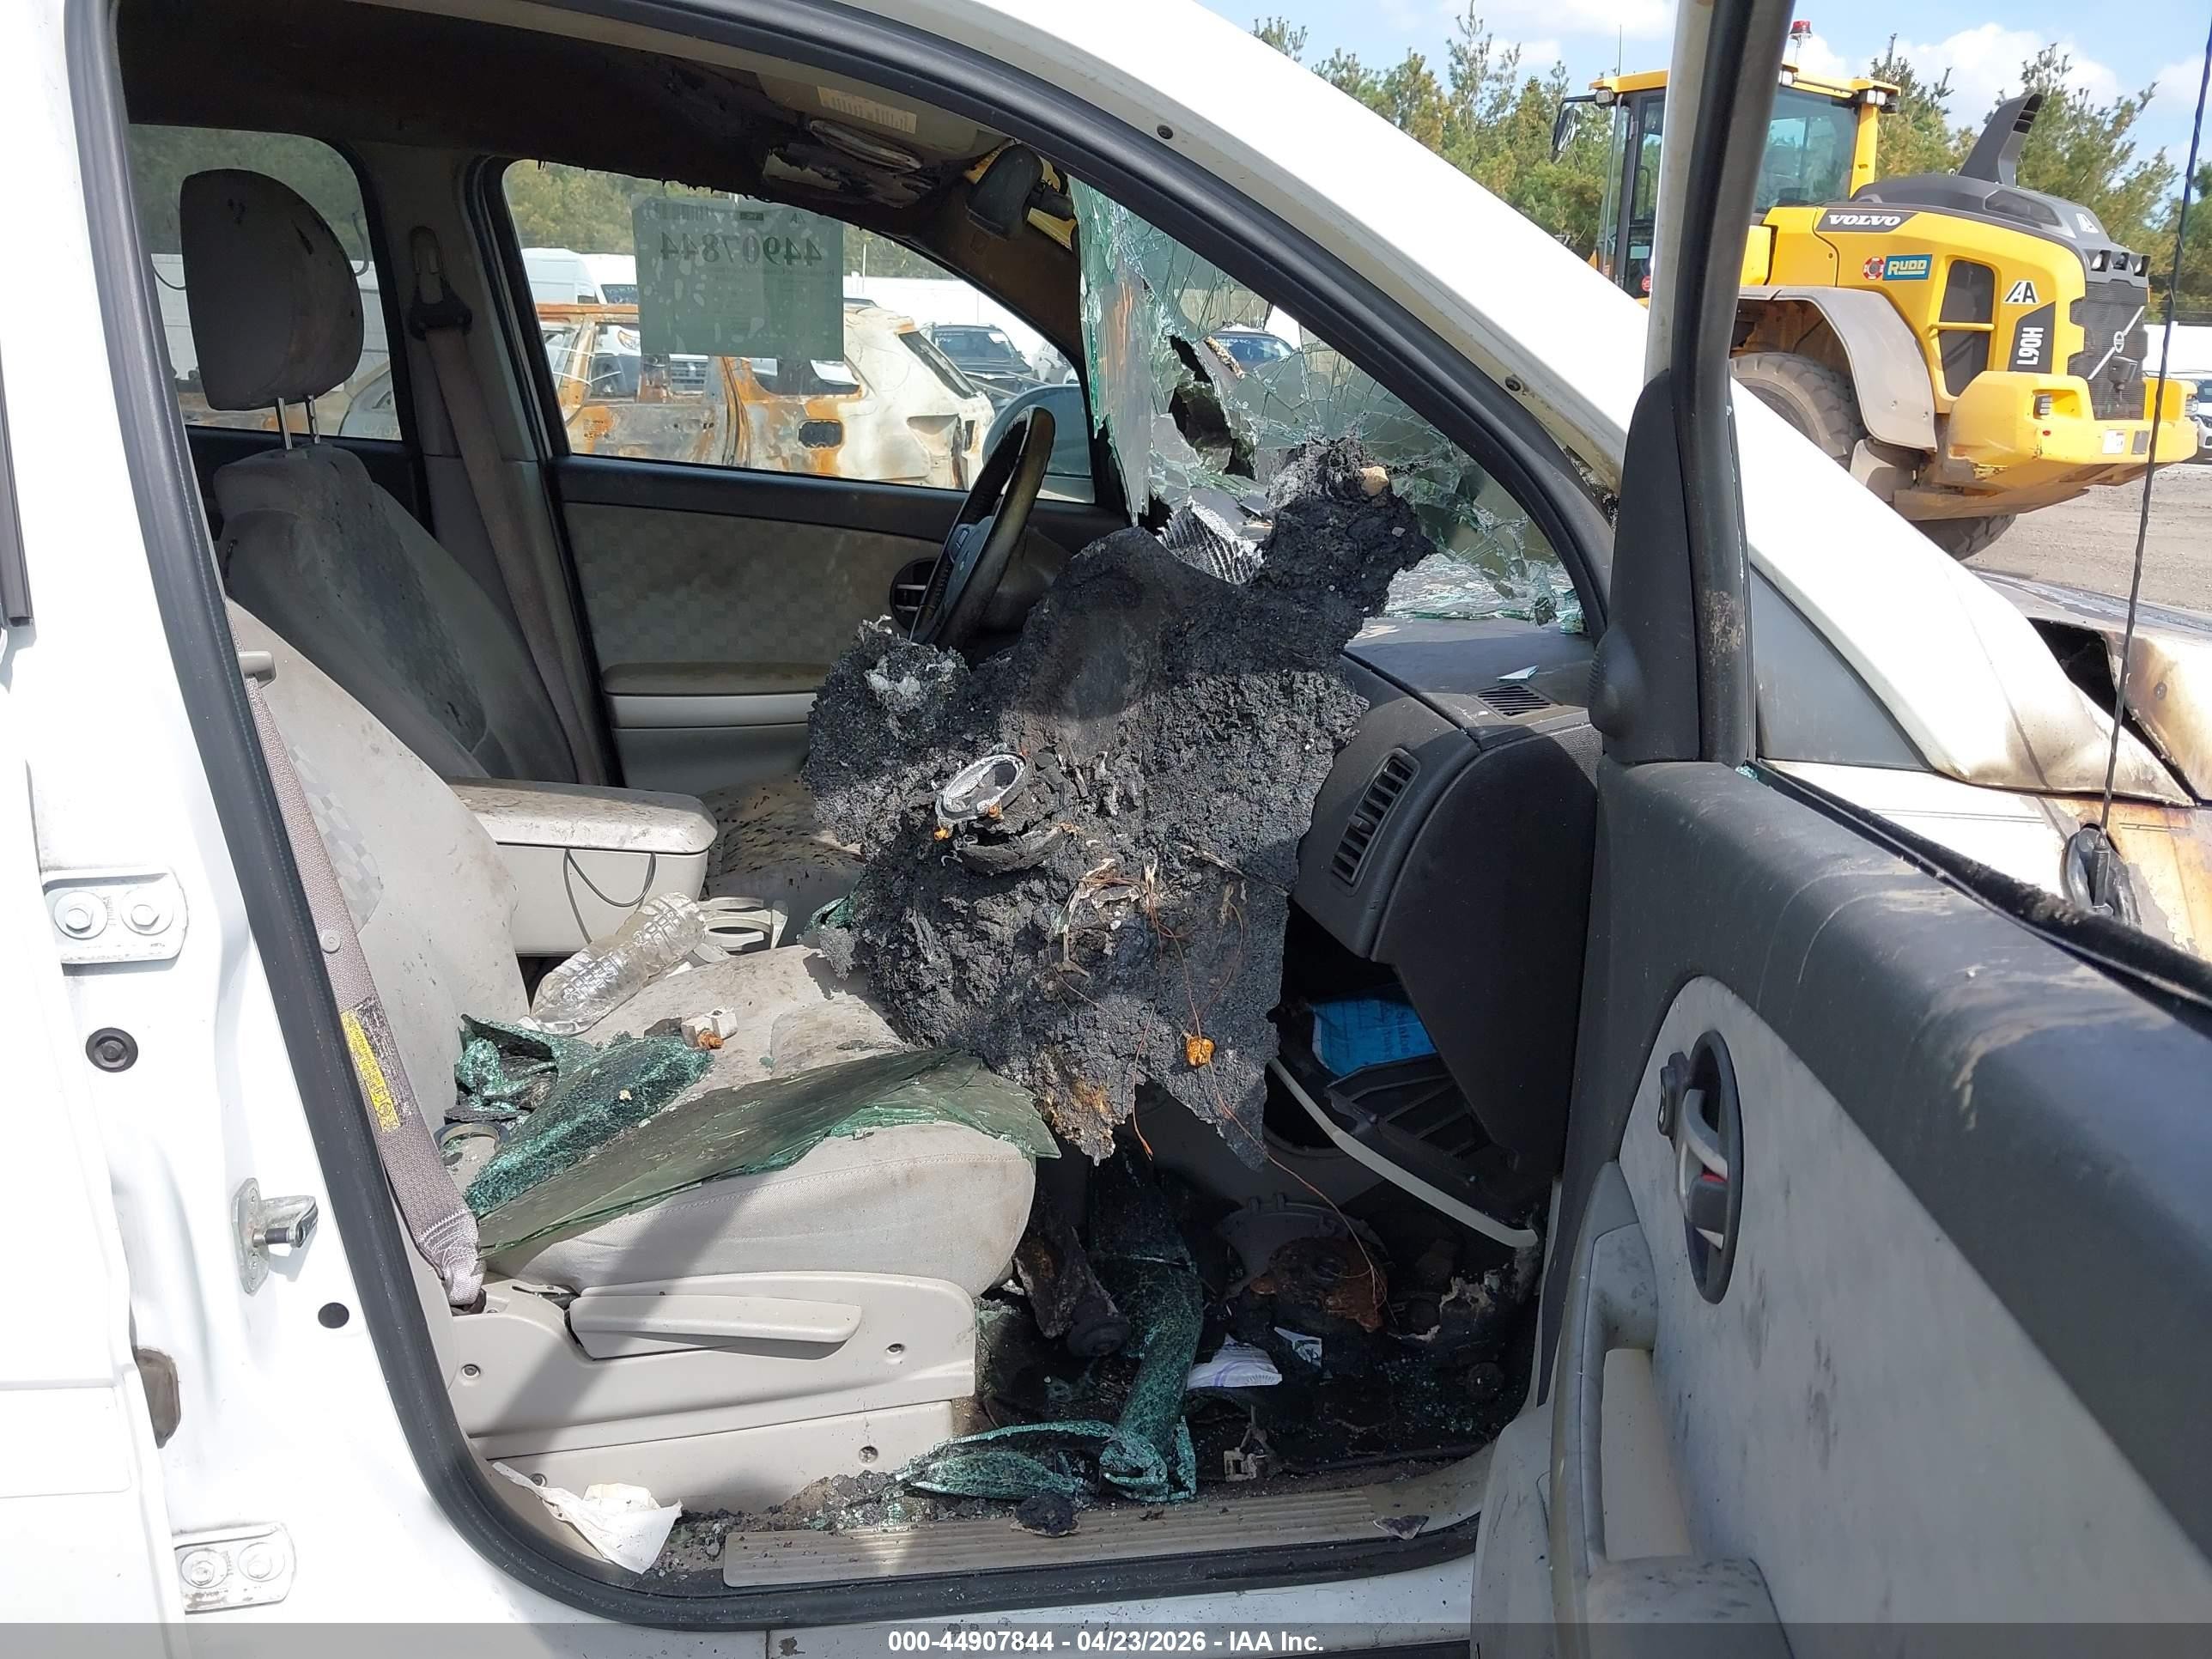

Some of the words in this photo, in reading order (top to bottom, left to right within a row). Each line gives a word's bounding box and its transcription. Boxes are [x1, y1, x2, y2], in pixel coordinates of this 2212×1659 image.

[1828, 214, 1901, 227] VOLVO
[1887, 259, 1928, 276] RUDD
[2016, 327, 2044, 366] L90H
